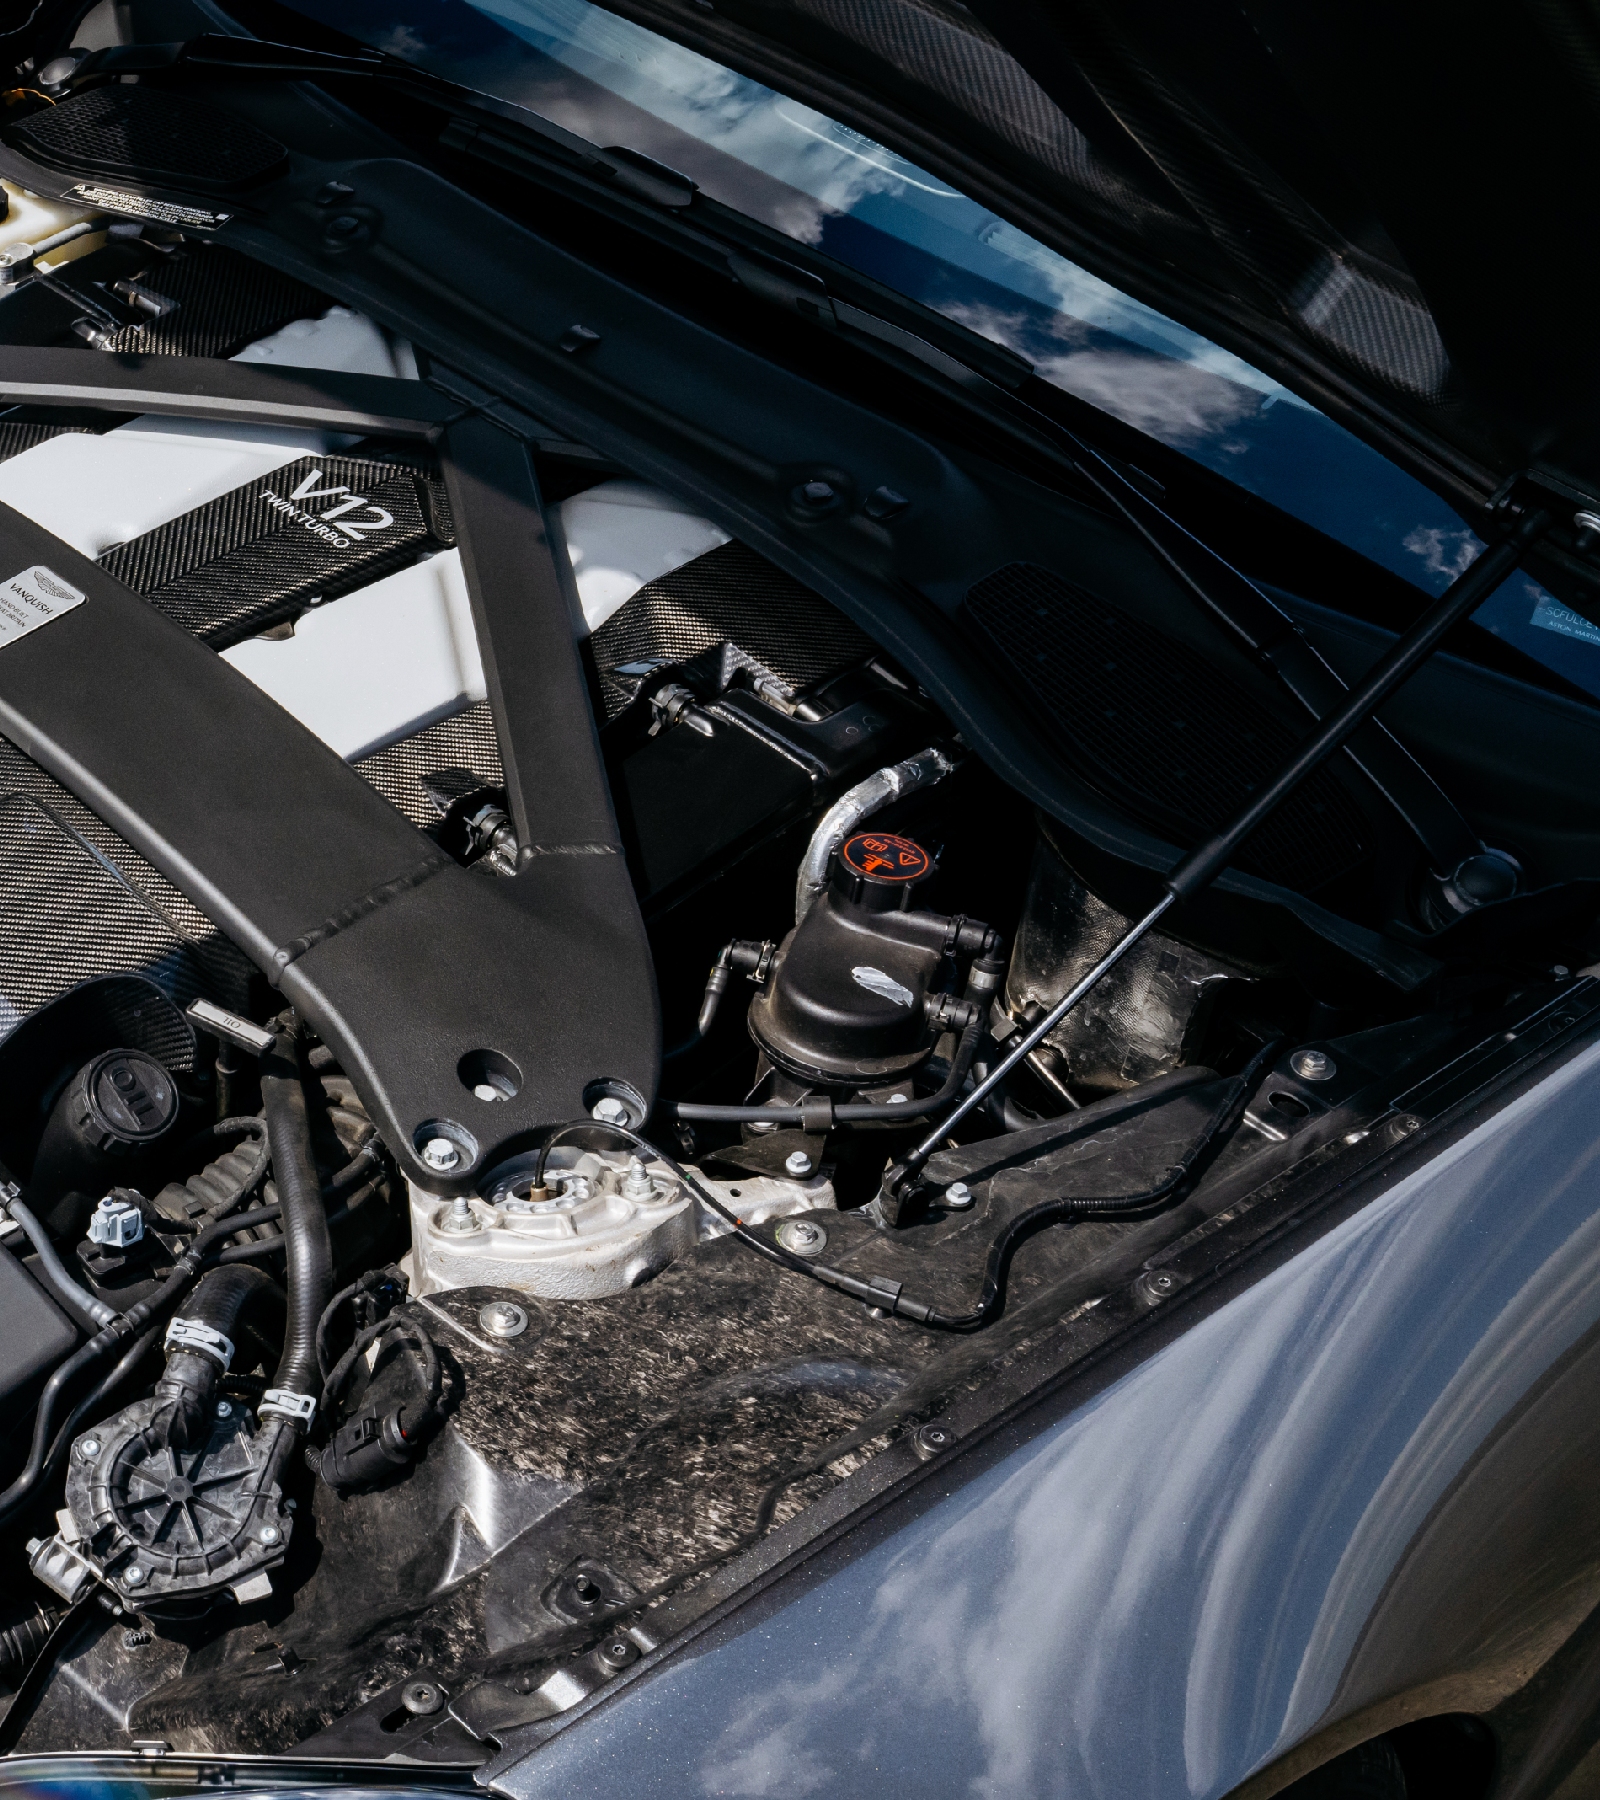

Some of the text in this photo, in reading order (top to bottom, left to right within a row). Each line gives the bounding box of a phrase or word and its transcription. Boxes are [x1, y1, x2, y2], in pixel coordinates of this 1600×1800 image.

[259, 490, 350, 548] TWIN TURBO
[290, 469, 393, 540] V12
[10, 583, 54, 615] VANQUISH
[1548, 620, 1571, 632] ASTON
[110, 1066, 155, 1126] OIL
